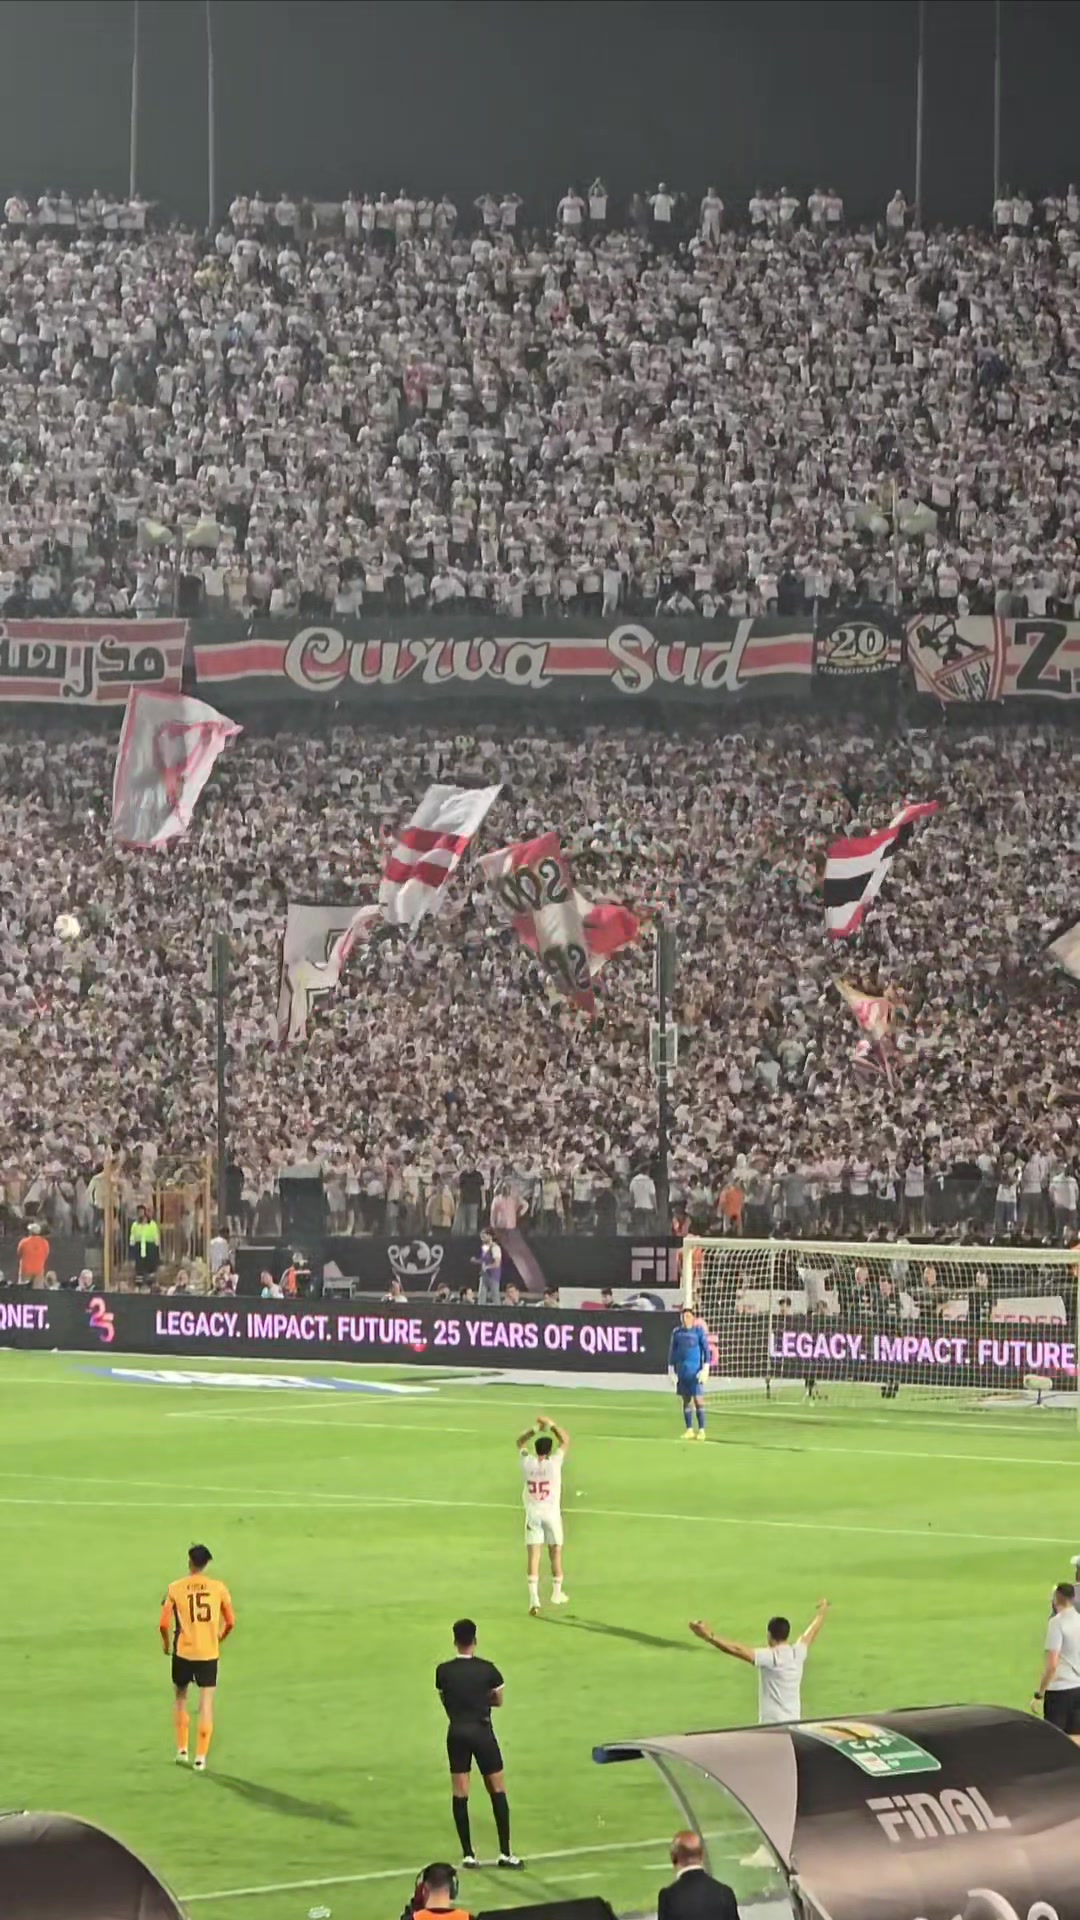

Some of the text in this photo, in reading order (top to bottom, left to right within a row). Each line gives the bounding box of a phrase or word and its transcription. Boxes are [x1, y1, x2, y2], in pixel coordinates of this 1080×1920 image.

[284, 618, 755, 694] Curva Sud
[830, 627, 885, 658] 20
[1014, 621, 1080, 693] Z
[155, 1310, 646, 1354] LEGACY. IMPACT. FUTURE. 25 YEARS OF QNET.
[769, 1331, 867, 1361] LEGACY.
[873, 1334, 971, 1365] IMPACT.
[187, 1592, 212, 1623] 15
